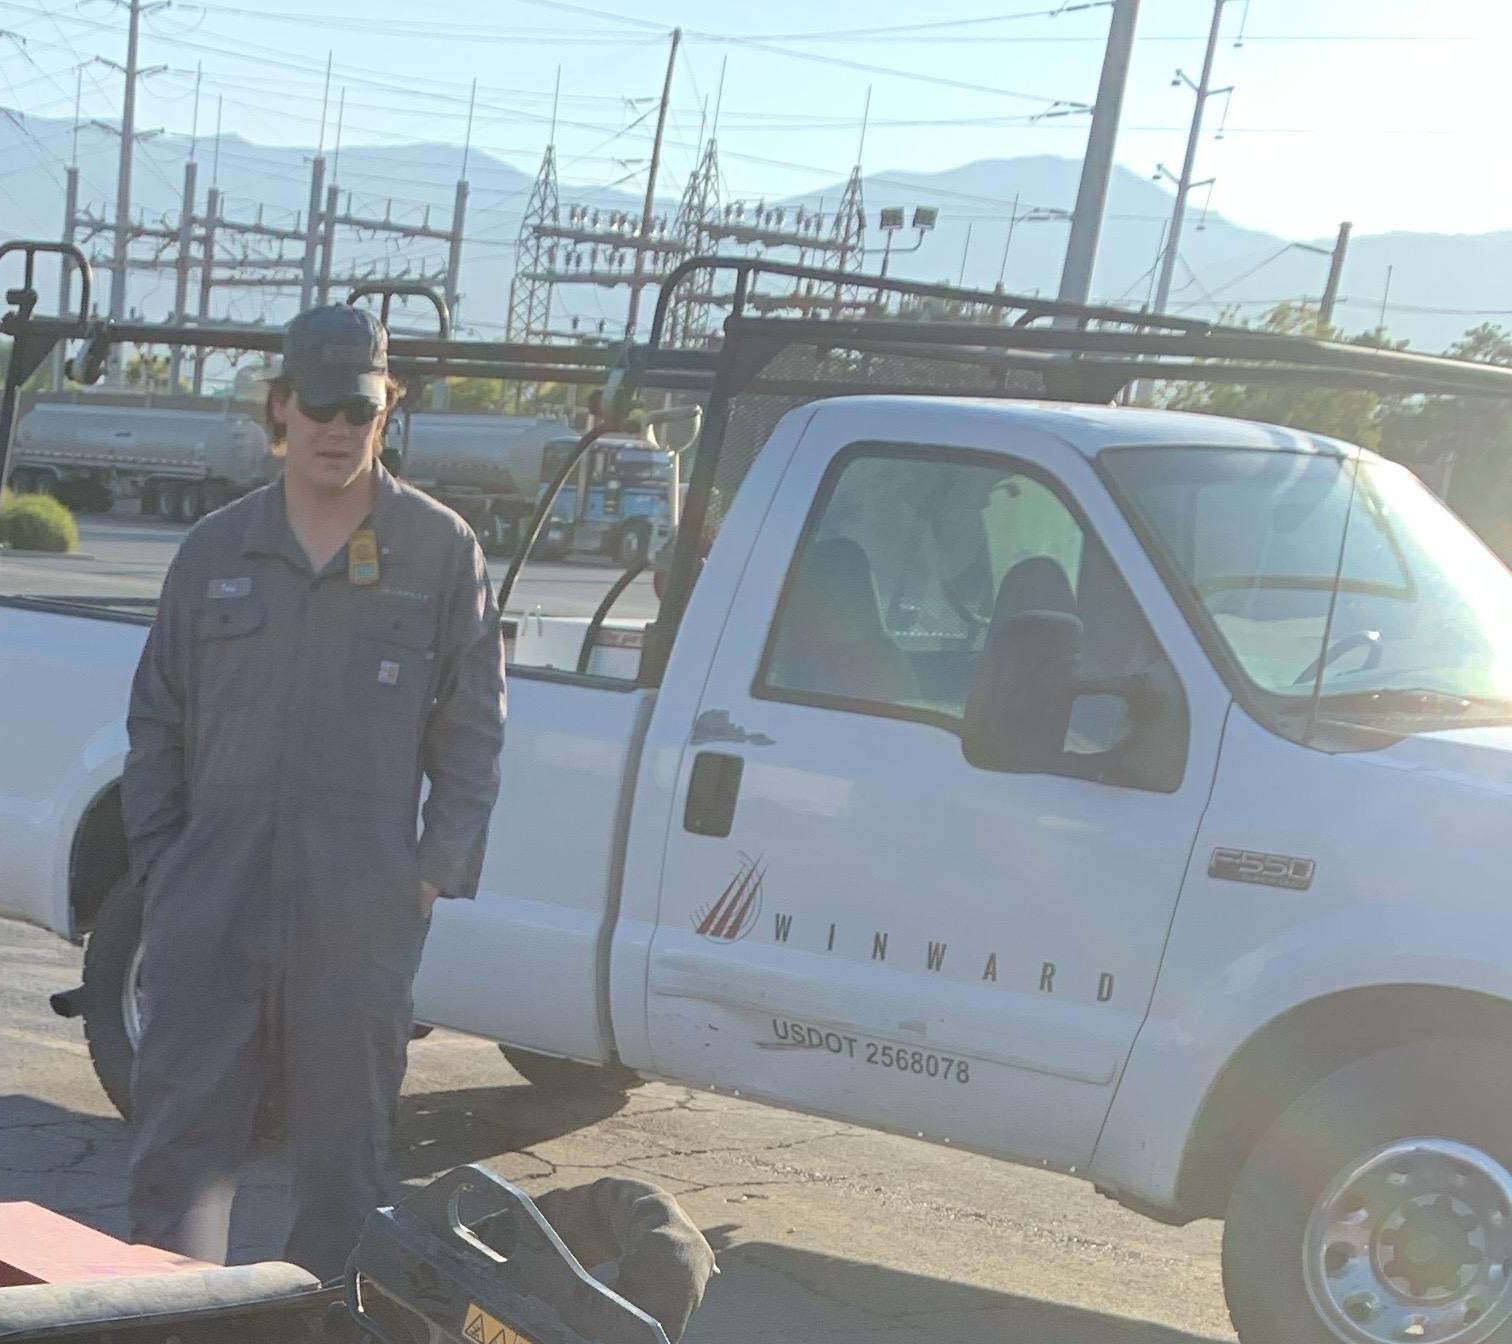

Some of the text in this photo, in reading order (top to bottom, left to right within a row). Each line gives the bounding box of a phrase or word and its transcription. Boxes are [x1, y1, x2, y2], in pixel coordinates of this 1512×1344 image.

[774, 912, 1114, 1002] WINWARD
[772, 1018, 970, 1084] USDOT 2568078
